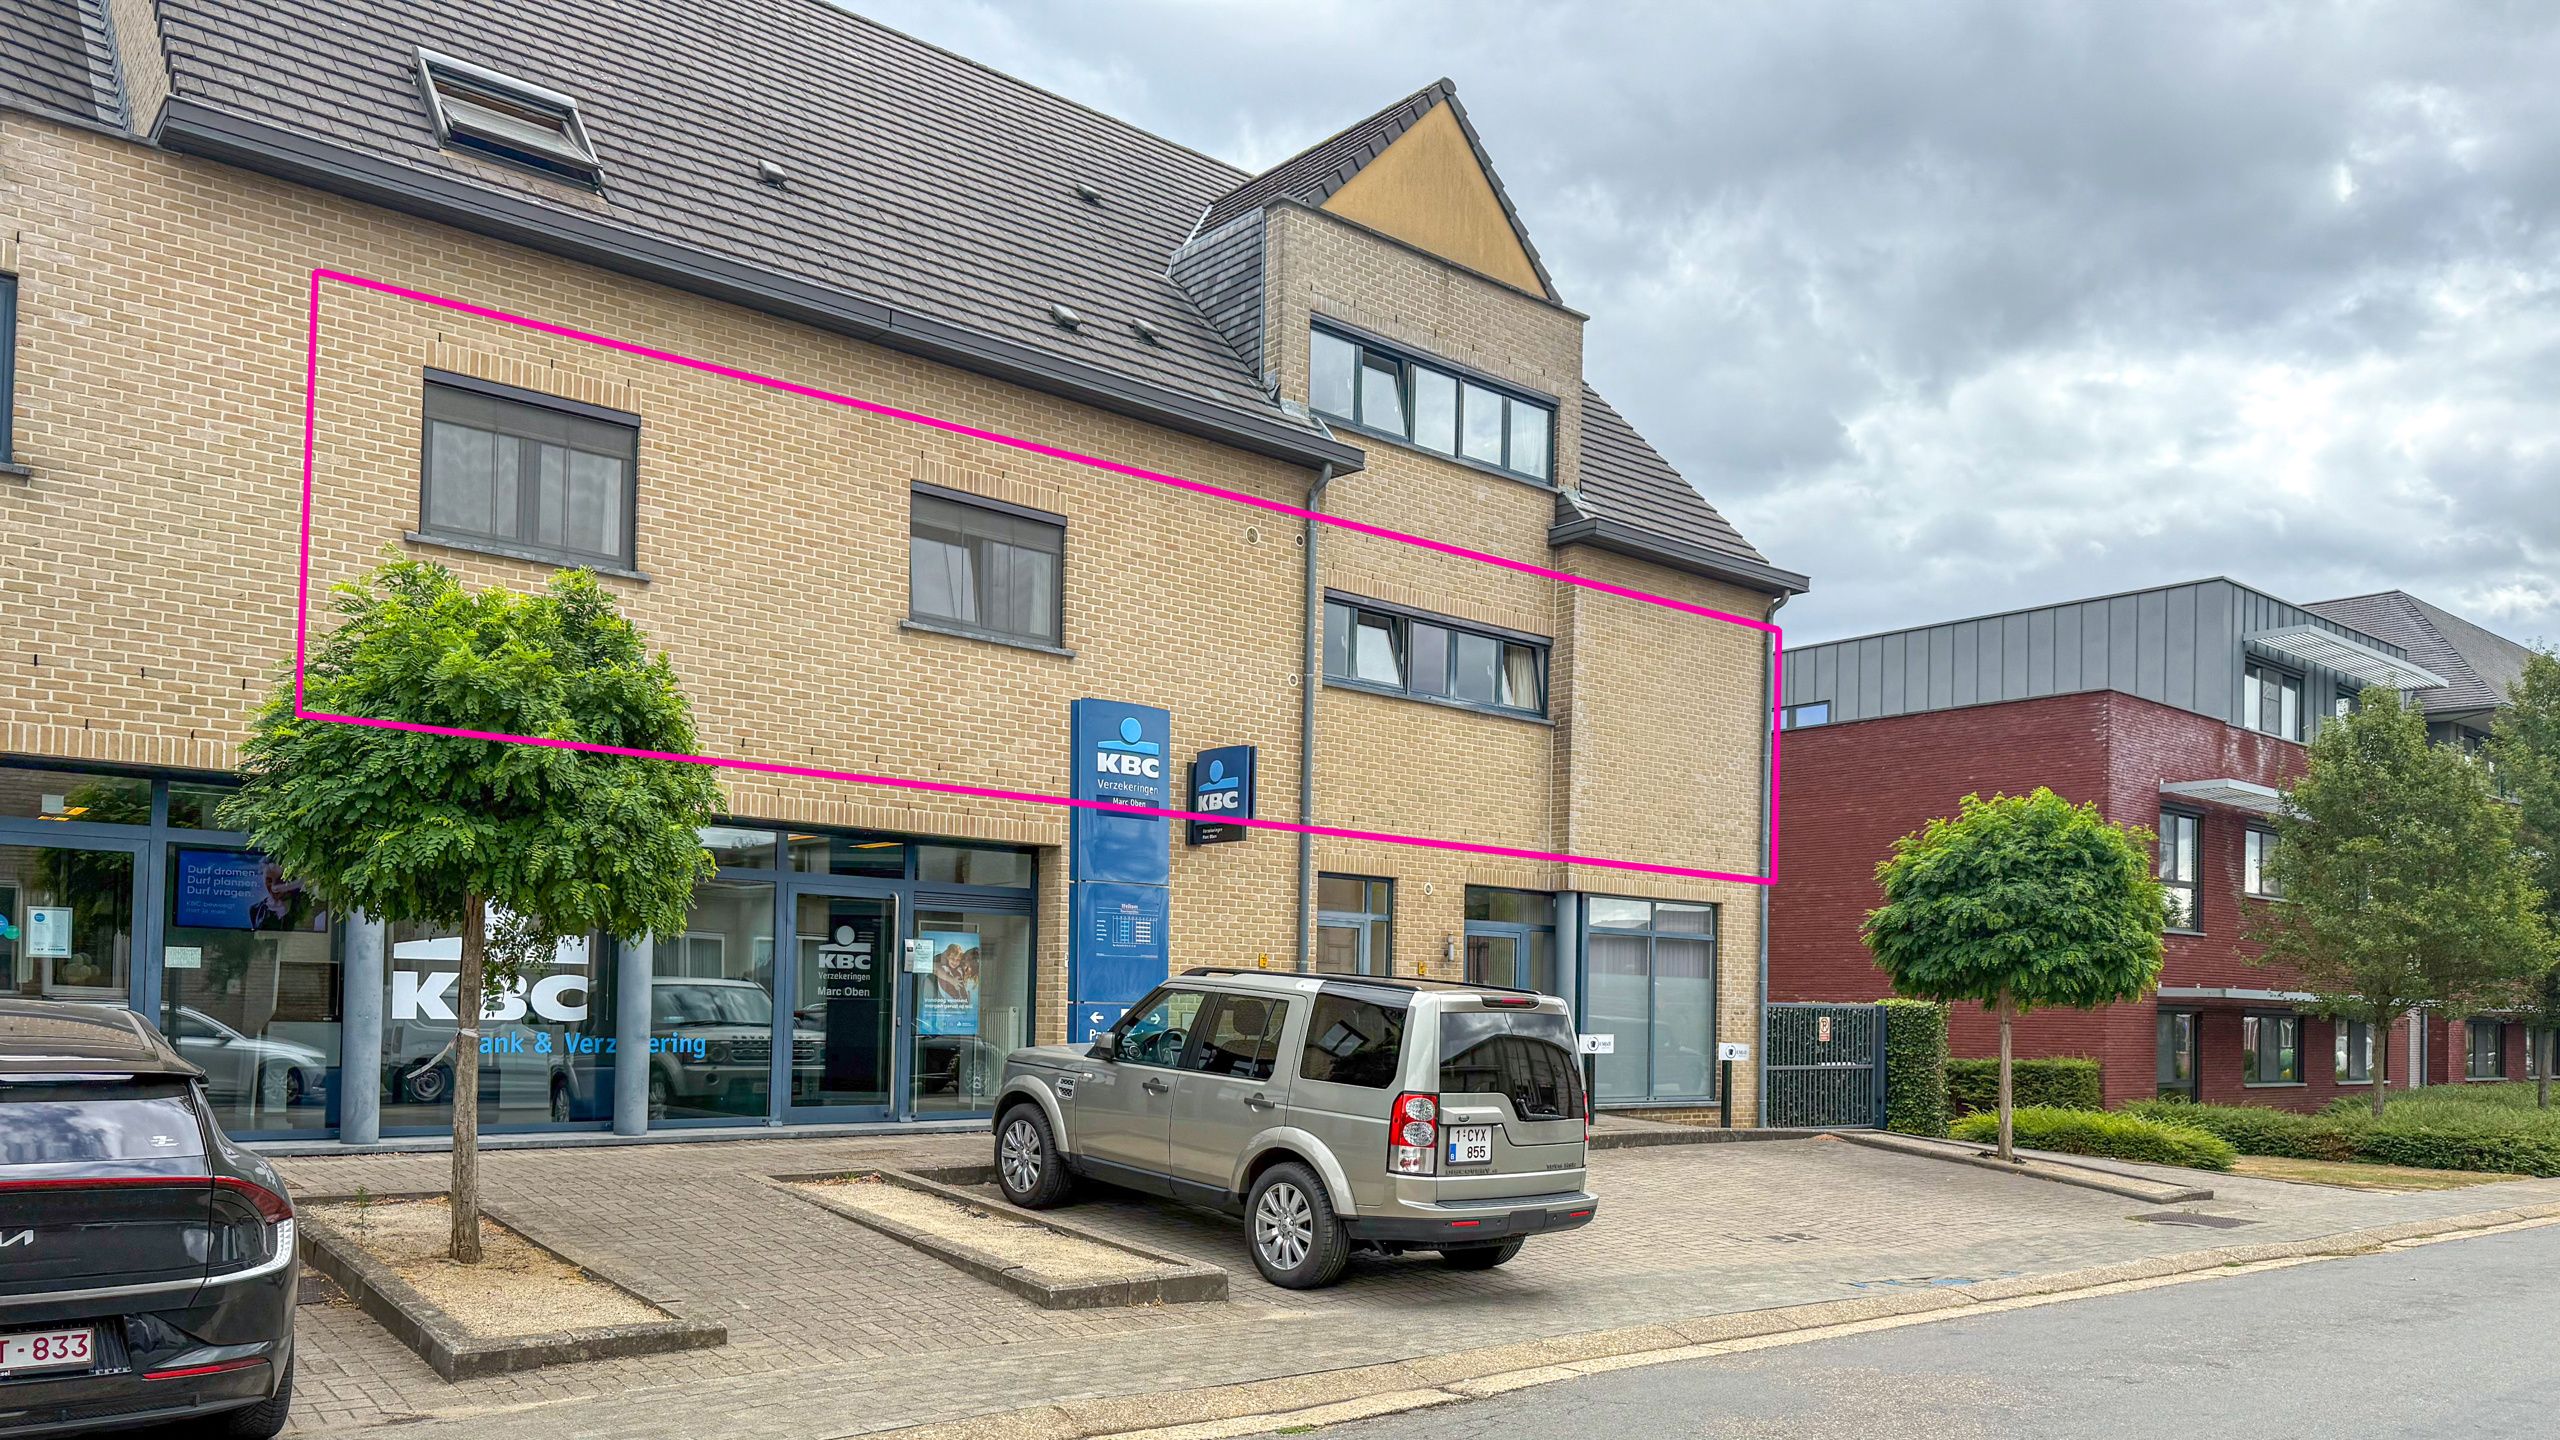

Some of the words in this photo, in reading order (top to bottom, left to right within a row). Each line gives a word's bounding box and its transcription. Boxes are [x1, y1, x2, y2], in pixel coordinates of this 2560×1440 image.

[1097, 752, 1160, 778] KBC
[1097, 779, 1159, 796] Verzekeringen
[1112, 797, 1128, 806] Marc
[1130, 798, 1146, 808] Oben
[1198, 791, 1238, 812] KBC
[187, 865, 211, 874] Durf
[187, 875, 210, 884] Durf
[187, 885, 210, 895] Durf
[818, 953, 871, 970] KBC
[818, 971, 871, 982] Verzekeringen
[817, 986, 842, 996] Marc
[844, 986, 870, 997] Oben
[479, 1031, 524, 1055] ank
[534, 1032, 552, 1054] &
[1467, 1146, 1486, 1159] 855
